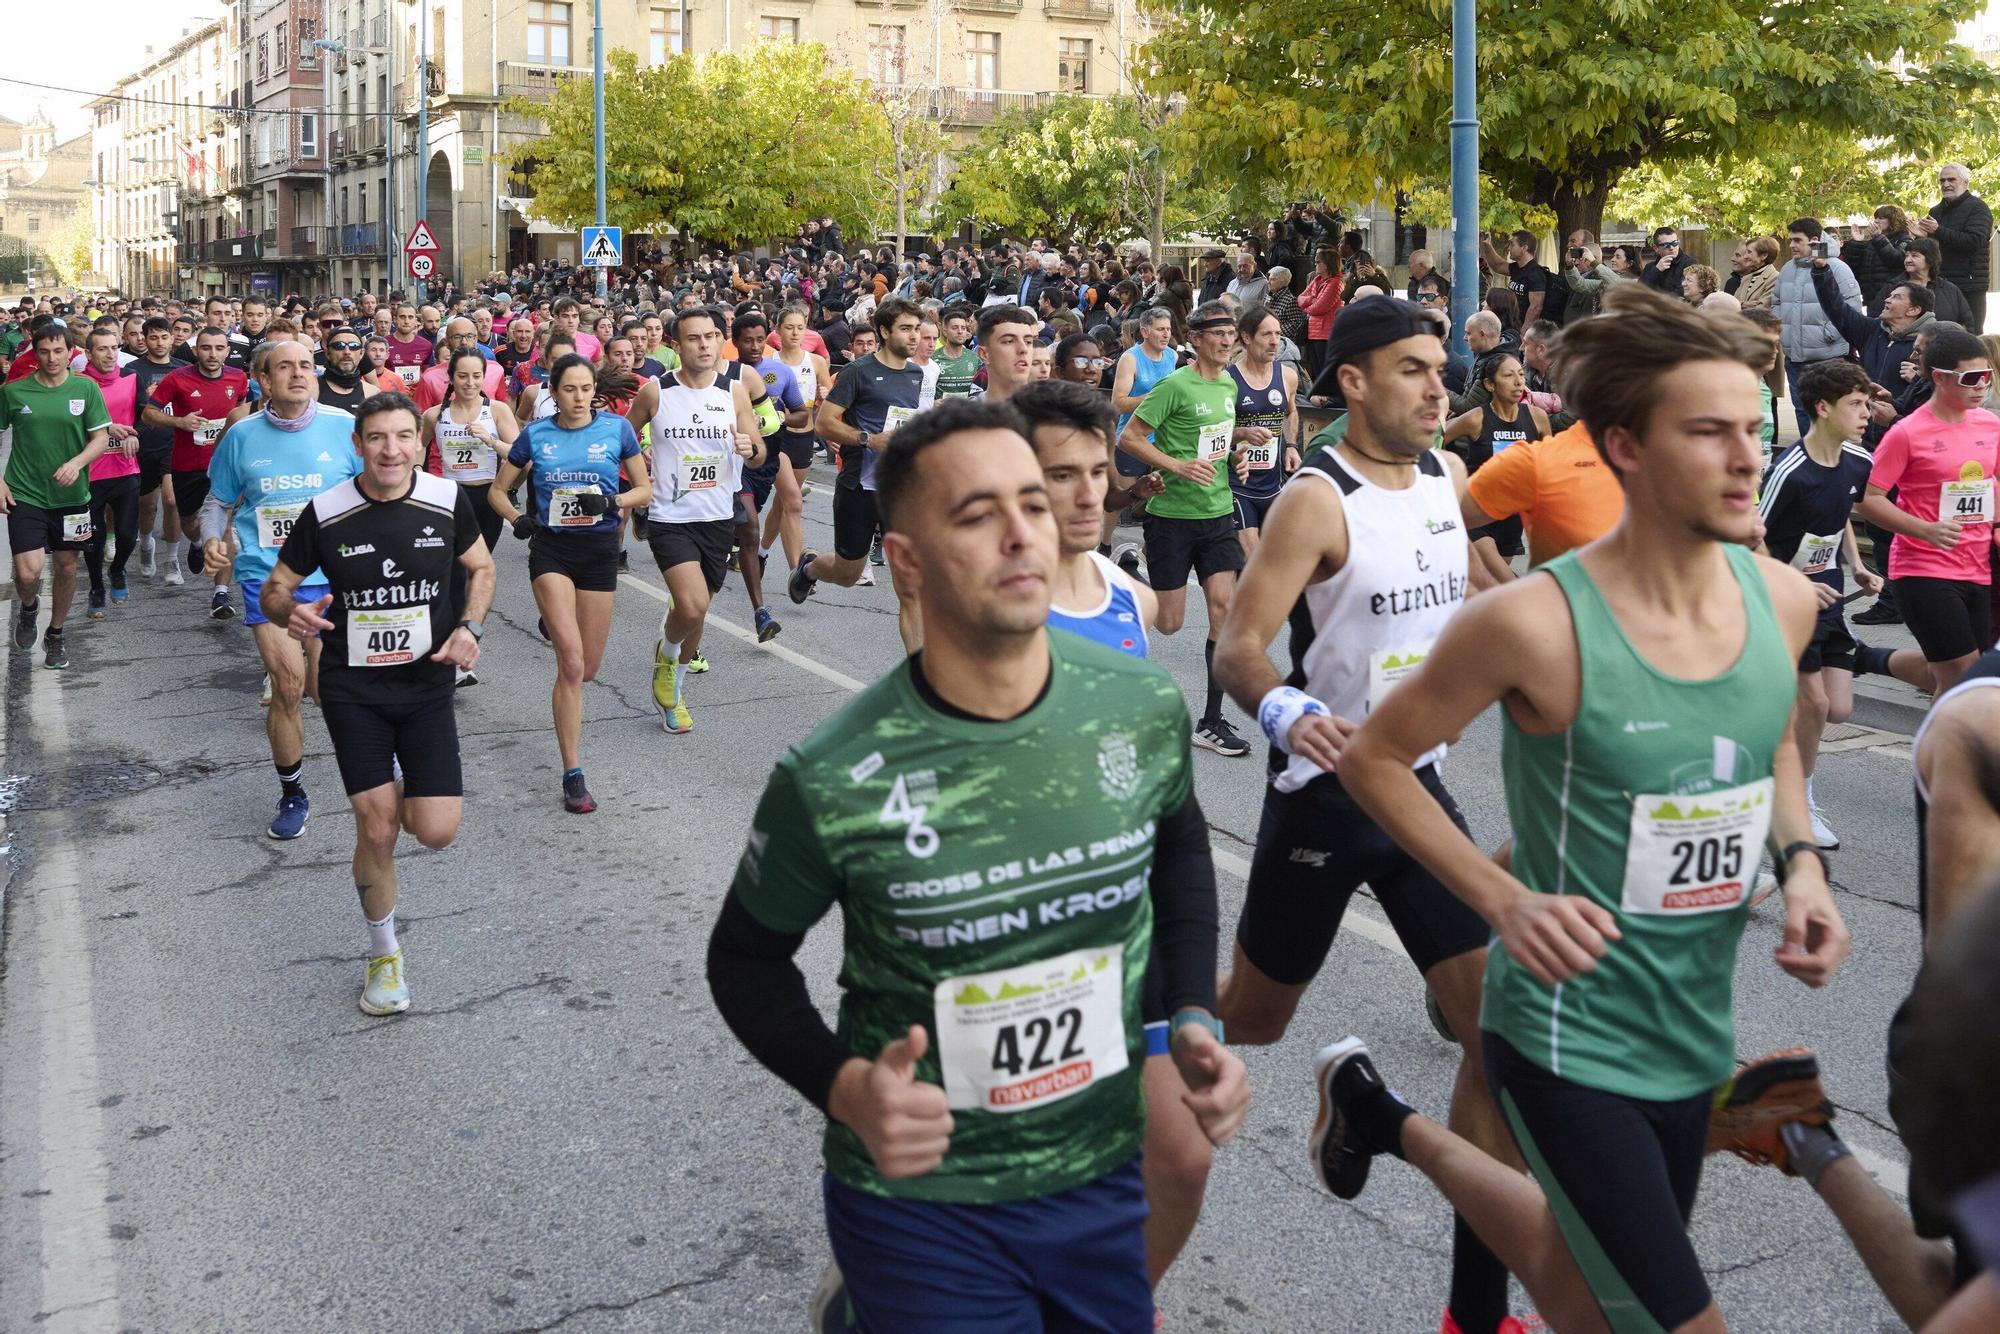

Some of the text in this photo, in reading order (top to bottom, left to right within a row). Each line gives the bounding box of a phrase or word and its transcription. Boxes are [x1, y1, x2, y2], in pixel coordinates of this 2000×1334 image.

[415, 261, 430, 270] 30
[402, 373, 414, 381] 145
[664, 425, 728, 439] etxenike
[1493, 430, 1527, 440] QUELLCA
[1211, 435, 1226, 452] 125
[456, 450, 473, 463] 22
[1247, 449, 1270, 462] 266
[545, 467, 600, 483] adentro
[690, 465, 716, 481] 246
[1956, 496, 1983, 514] 441
[1808, 547, 1834, 565] 409
[368, 630, 411, 653] 402
[888, 819, 1156, 900] CROSS DE LAS PEÑAS
[1669, 833, 1743, 885] 205
[896, 907, 1029, 948] PEÑEN
[992, 1007, 1085, 1076] 422
[993, 1065, 1091, 1105] navarban
